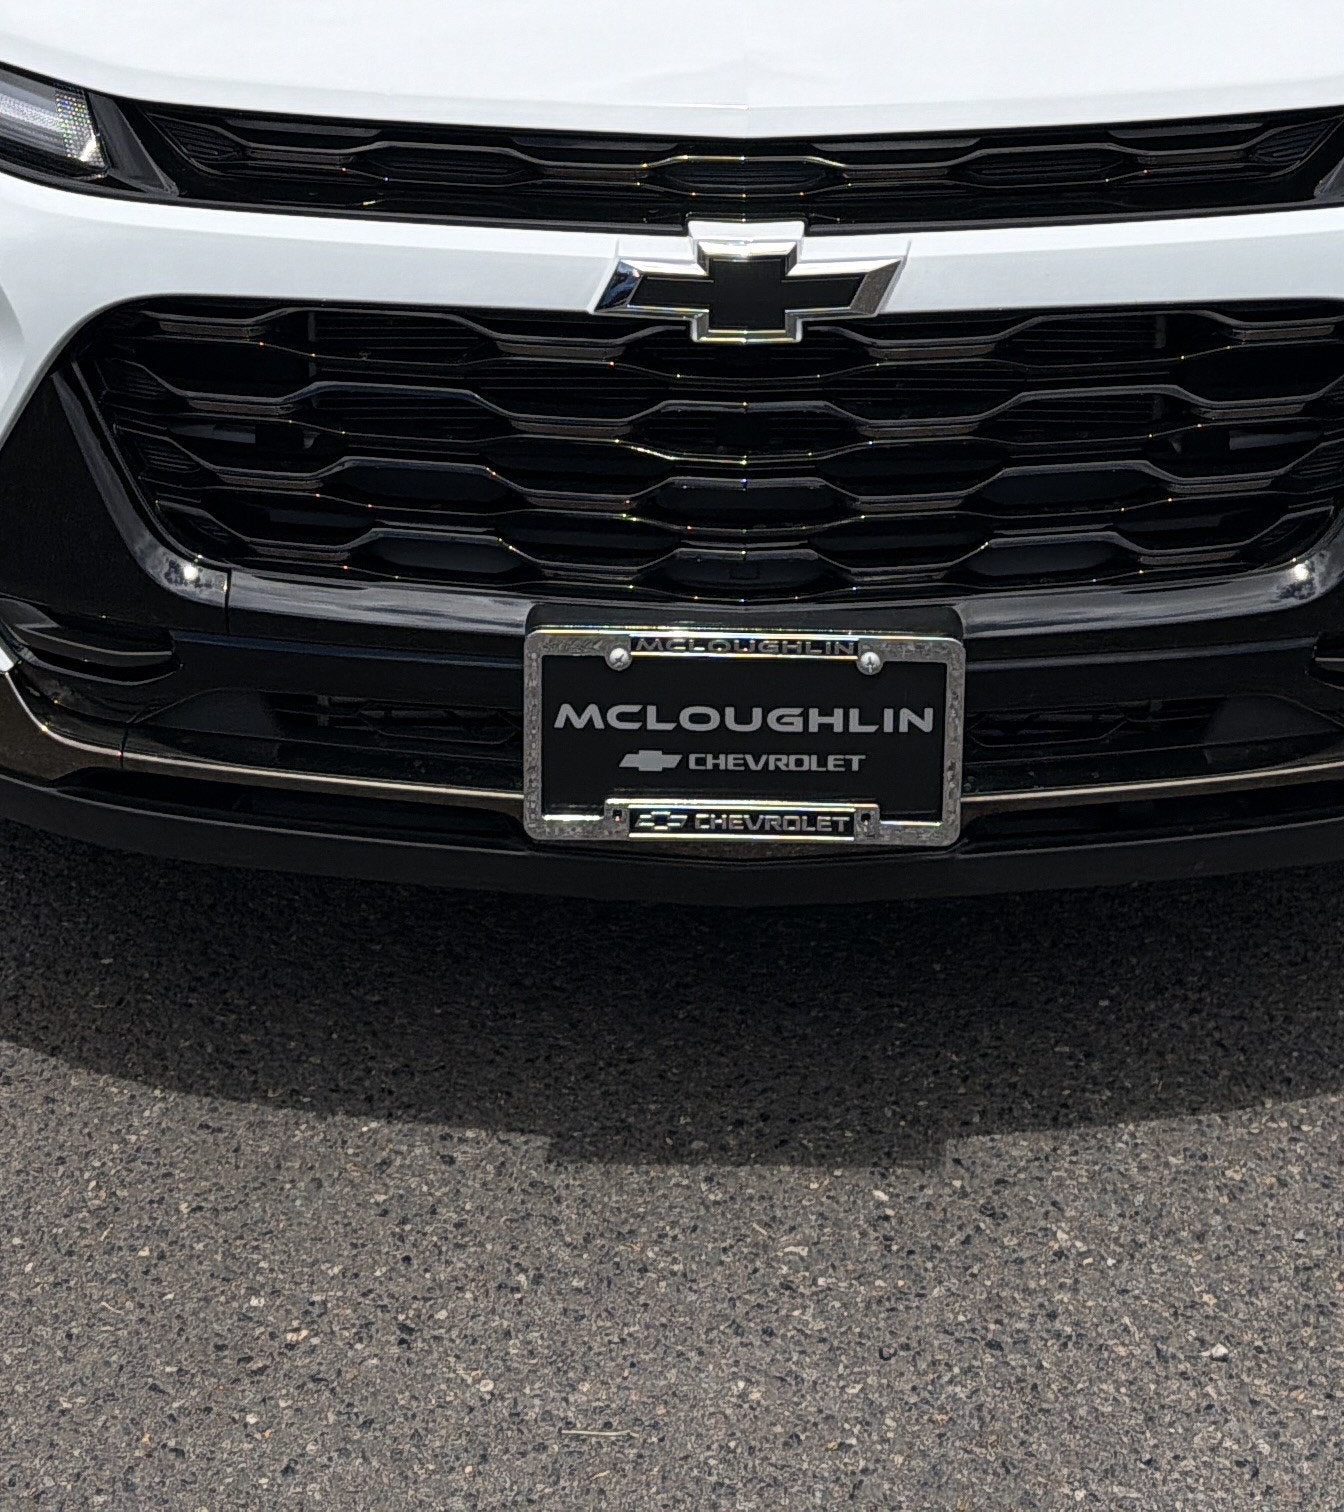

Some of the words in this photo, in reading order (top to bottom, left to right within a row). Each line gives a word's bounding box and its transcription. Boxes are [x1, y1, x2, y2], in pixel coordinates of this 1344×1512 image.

[635, 639, 856, 655] MCLOUGHLIN
[554, 704, 933, 732] MCLOUGHLIN
[689, 754, 865, 771] CHEVROLET
[694, 813, 851, 832] CHEVROLET
